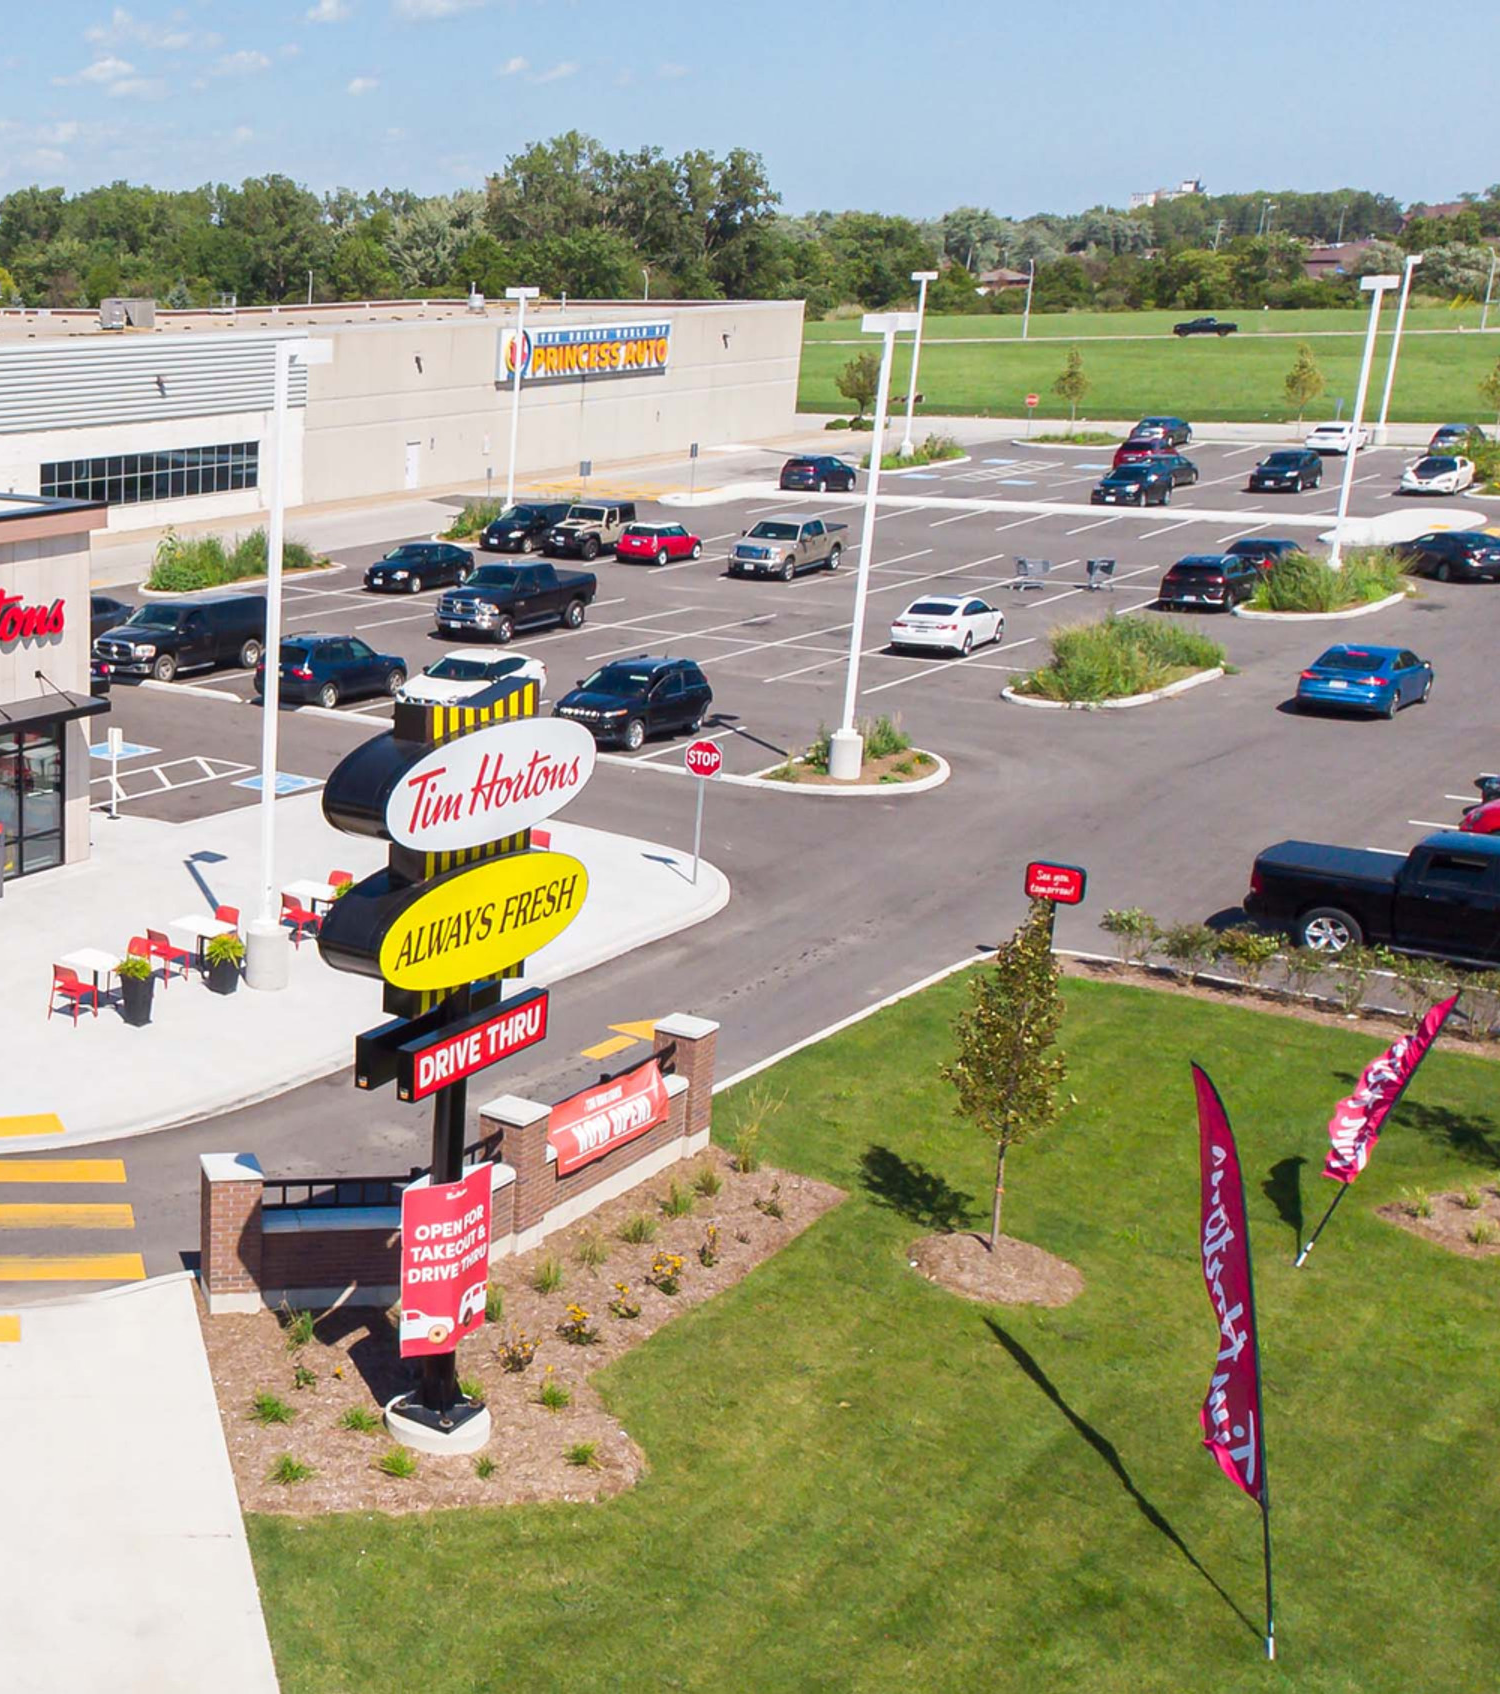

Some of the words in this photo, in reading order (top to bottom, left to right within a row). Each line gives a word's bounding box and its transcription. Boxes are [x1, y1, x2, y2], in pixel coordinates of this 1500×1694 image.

[532, 342, 621, 373] PRINCESS
[624, 338, 668, 365] AUTO
[688, 749, 720, 767] STOP
[407, 766, 462, 834] Tim
[468, 750, 580, 815] Hortons
[1036, 869, 1051, 881] See
[393, 902, 493, 972] ALWAYS
[499, 874, 579, 934] FRESH
[418, 1031, 482, 1091] DRIVE
[486, 1005, 542, 1055] THRU
[571, 1112, 611, 1154] NOW
[410, 1228, 477, 1263] TAKEOUT
[477, 1223, 487, 1241] &
[414, 1218, 463, 1242] OPEN
[463, 1203, 485, 1231] FOR
[407, 1261, 459, 1285] DRIVE
[460, 1241, 488, 1273] THRU
